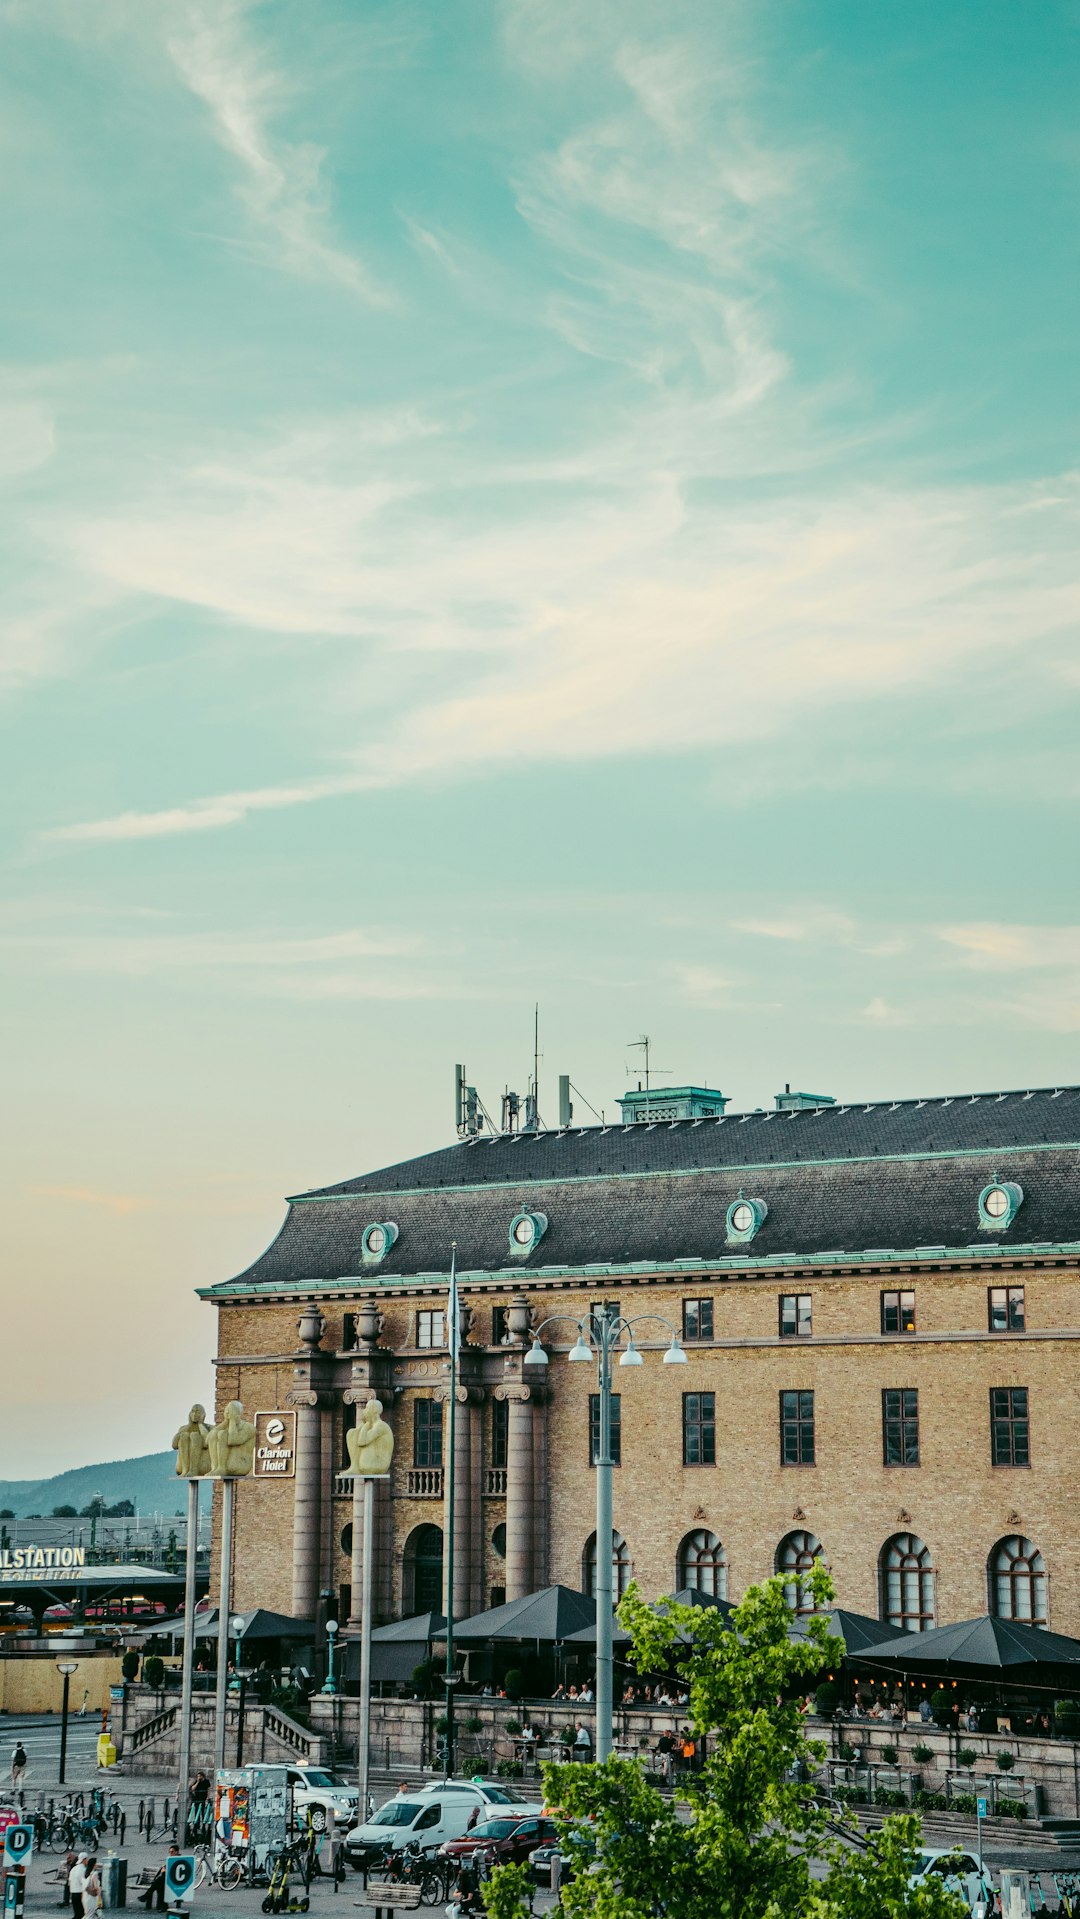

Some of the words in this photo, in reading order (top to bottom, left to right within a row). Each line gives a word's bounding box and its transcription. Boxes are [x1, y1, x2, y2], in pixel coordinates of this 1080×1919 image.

[258, 1446, 291, 1458] Clarion
[262, 1459, 286, 1471] Hotel
[0, 1548, 85, 1568] LSTATION
[14, 1832, 25, 1848] D
[175, 1864, 186, 1882] C
